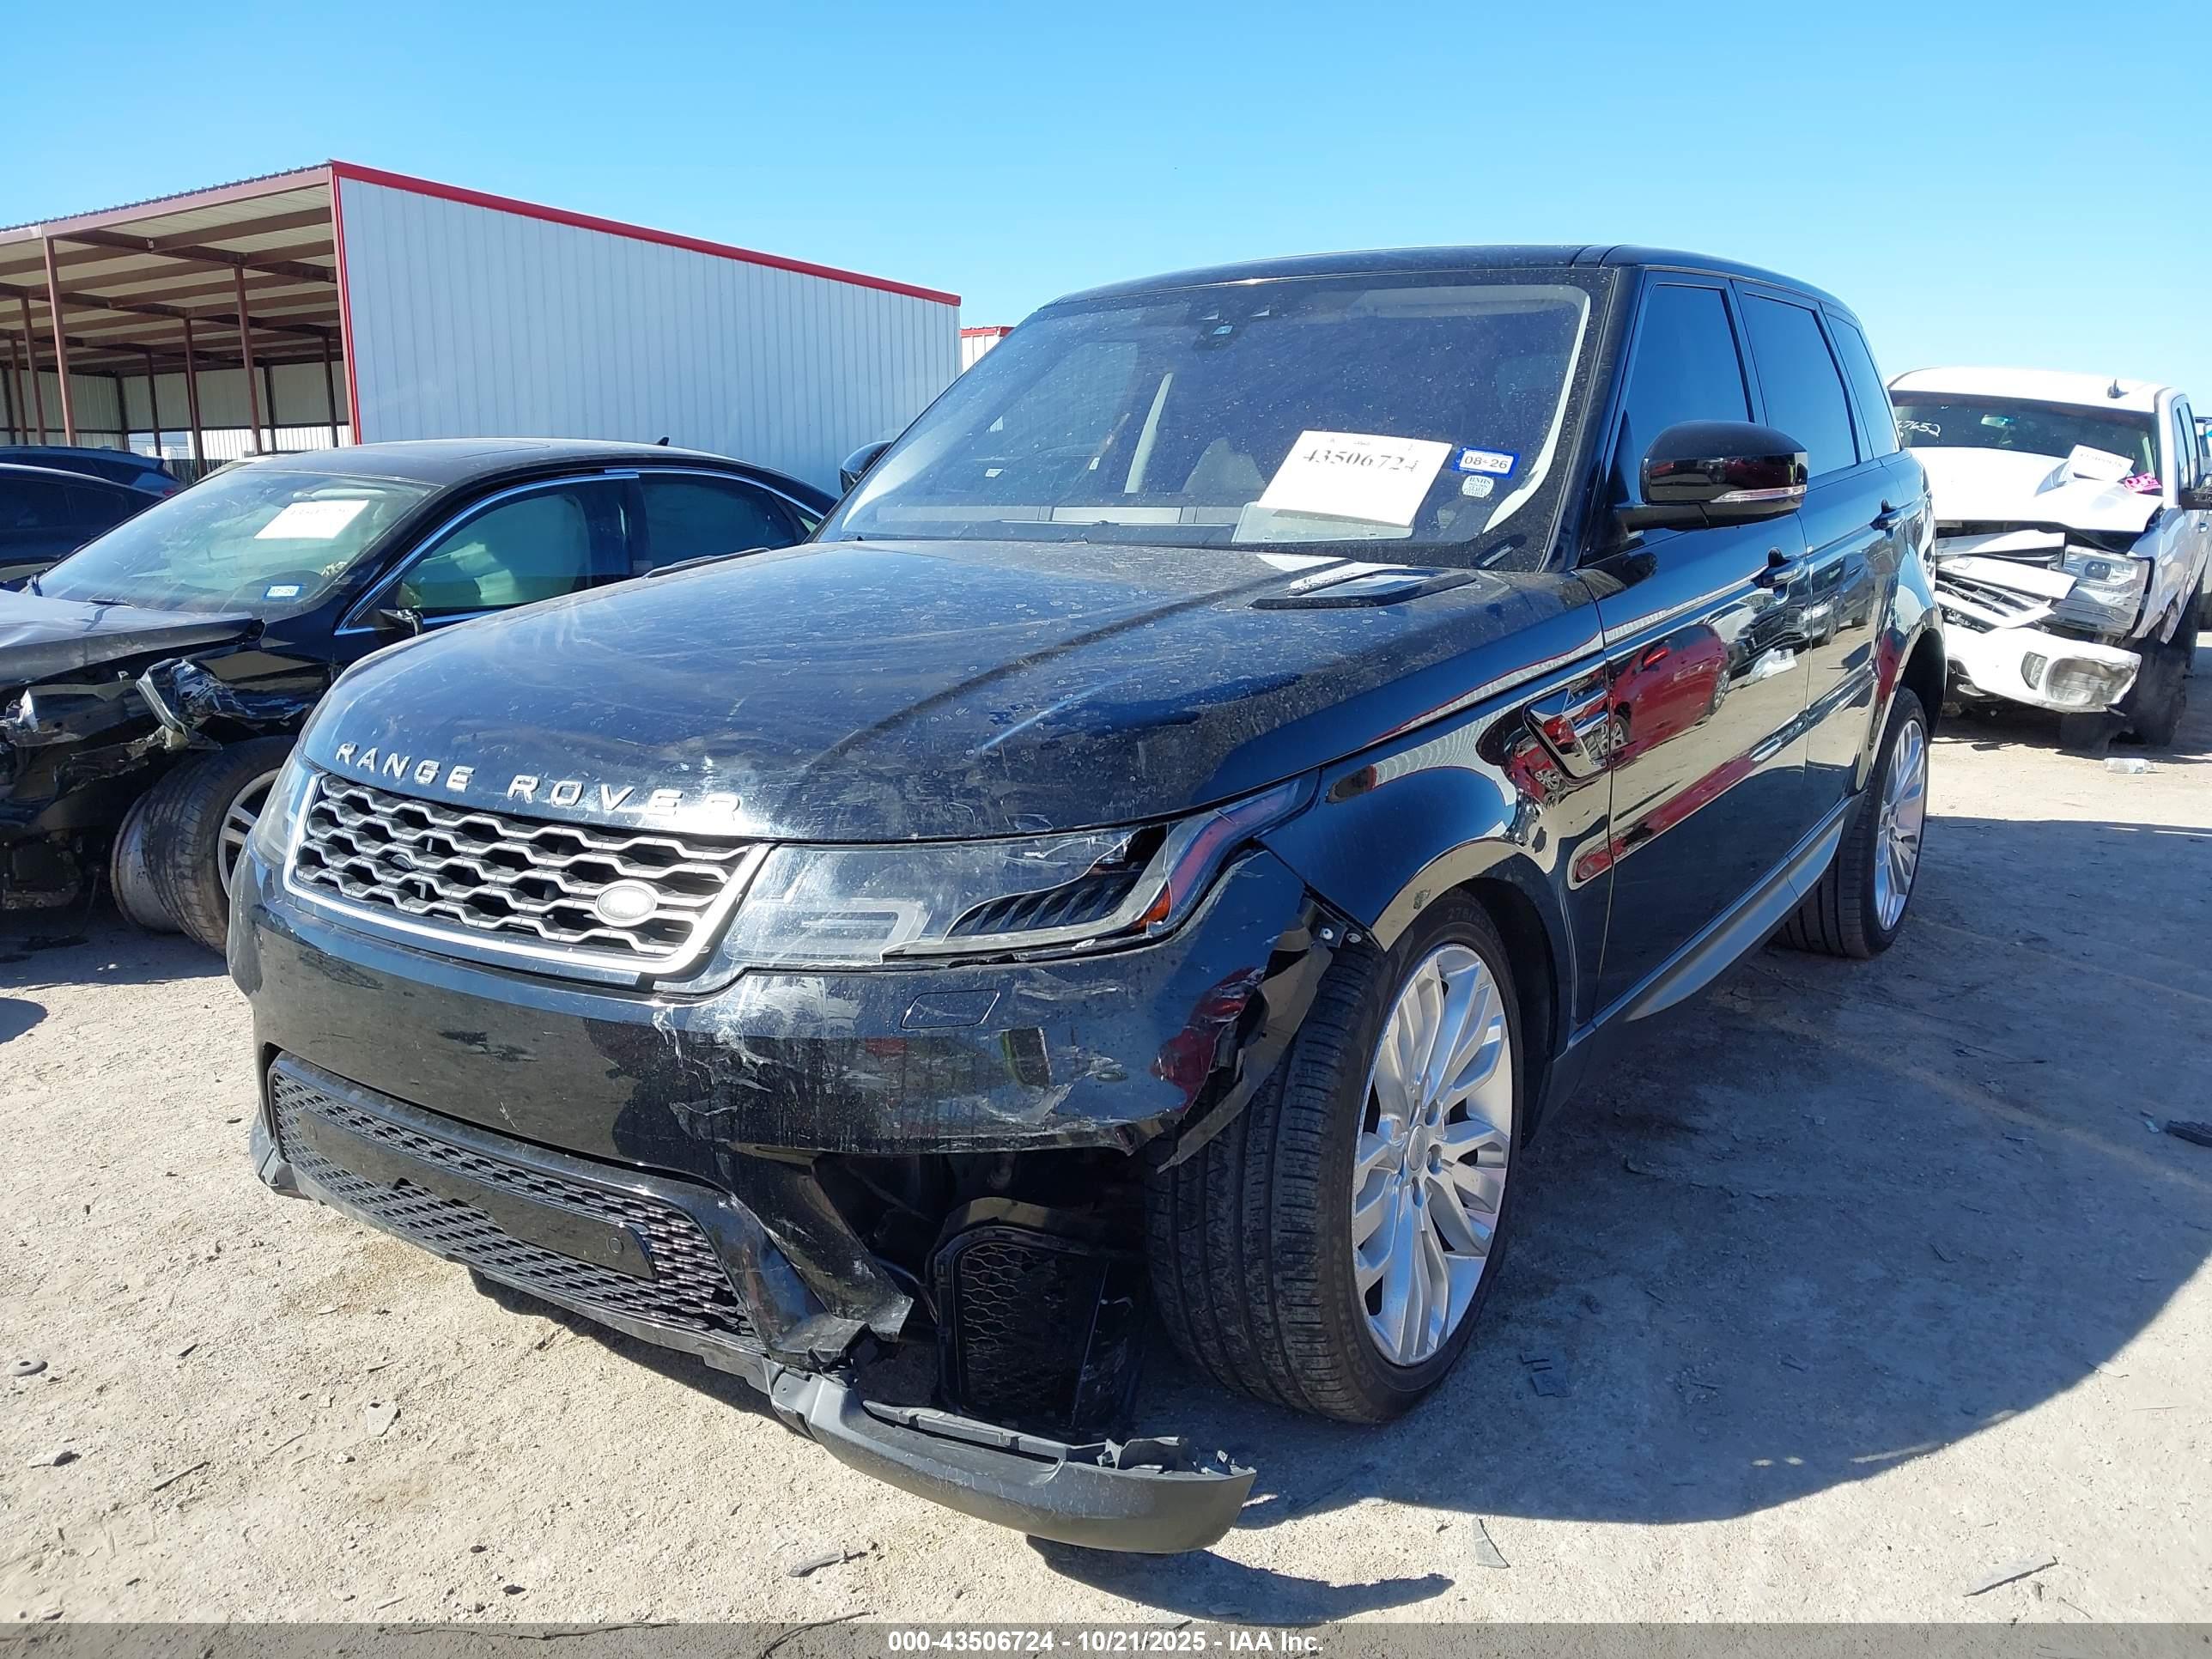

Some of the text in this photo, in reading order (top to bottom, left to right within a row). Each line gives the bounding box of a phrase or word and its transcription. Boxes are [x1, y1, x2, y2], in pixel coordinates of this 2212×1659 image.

[1303, 449, 1419, 472] 43506724
[1464, 455, 1509, 469] 08-26
[335, 742, 742, 819] RANGE ROVER
